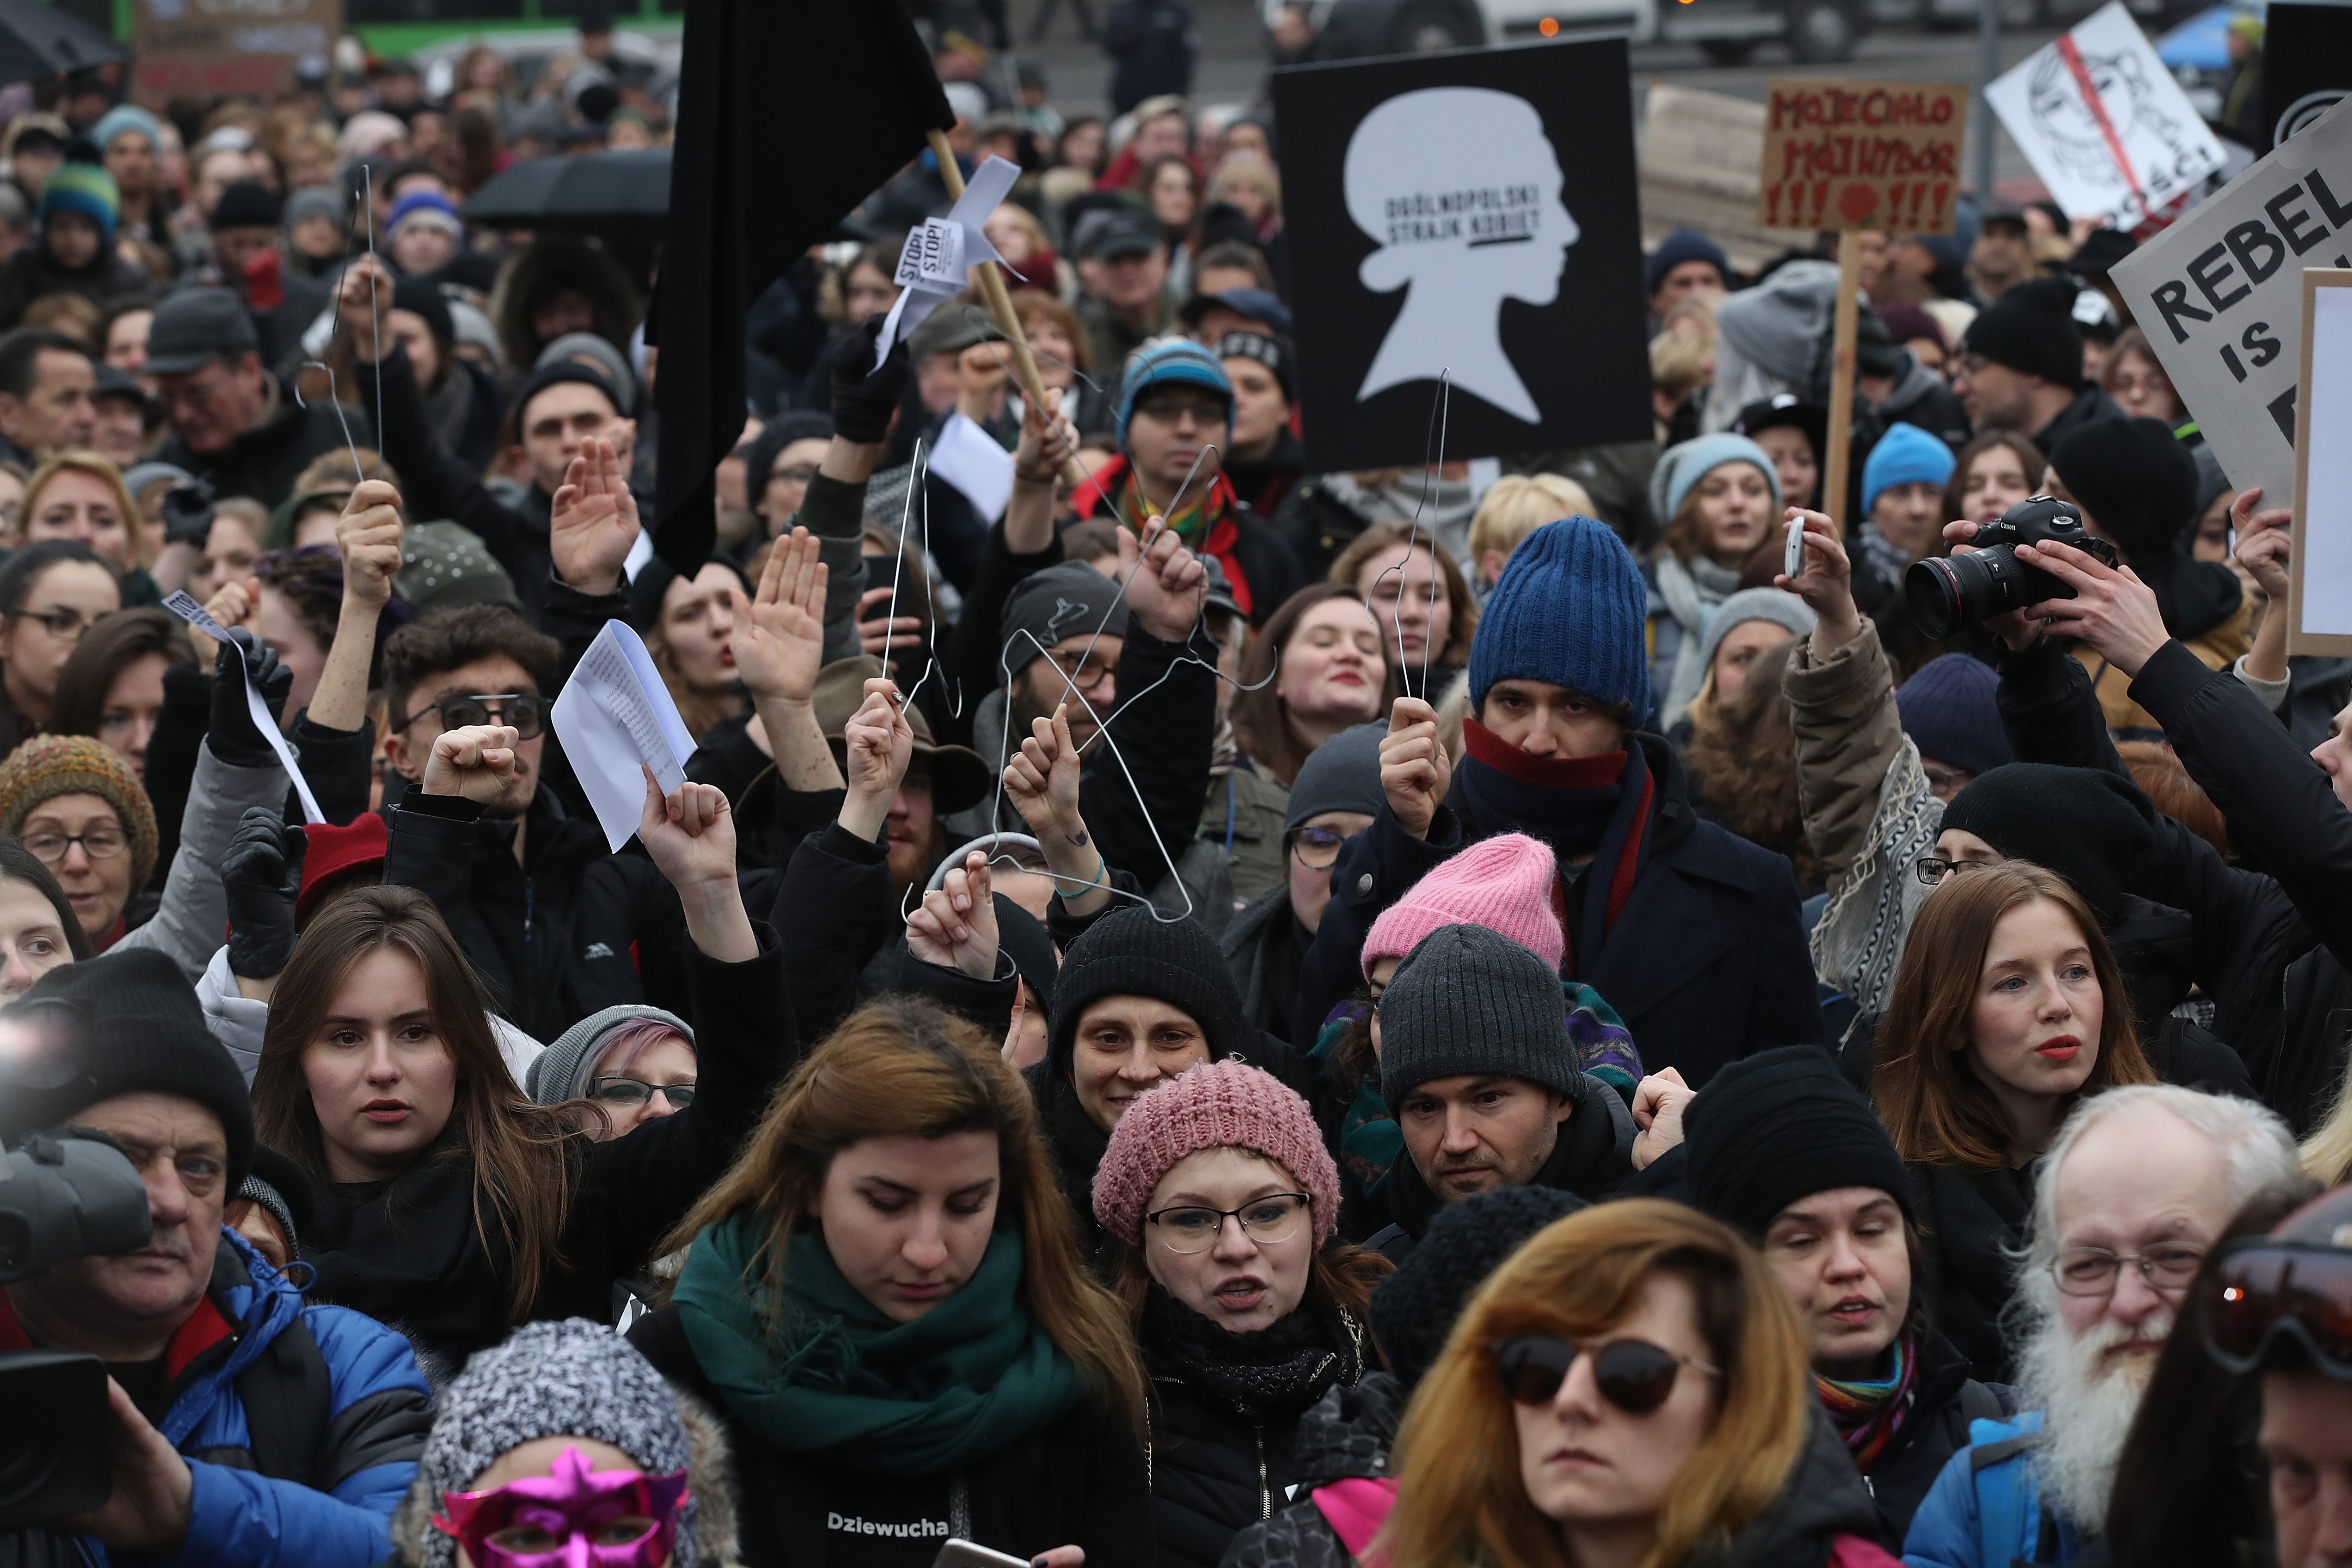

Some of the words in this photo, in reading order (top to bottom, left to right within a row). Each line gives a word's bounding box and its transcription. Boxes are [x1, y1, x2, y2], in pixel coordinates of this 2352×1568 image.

[1387, 217, 1462, 245] STRAJK
[2150, 168, 2352, 344] REBEL
[2220, 322, 2282, 383] IS
[2000, 521, 2016, 531] Canon
[827, 1511, 949, 1537] Dziewucha
